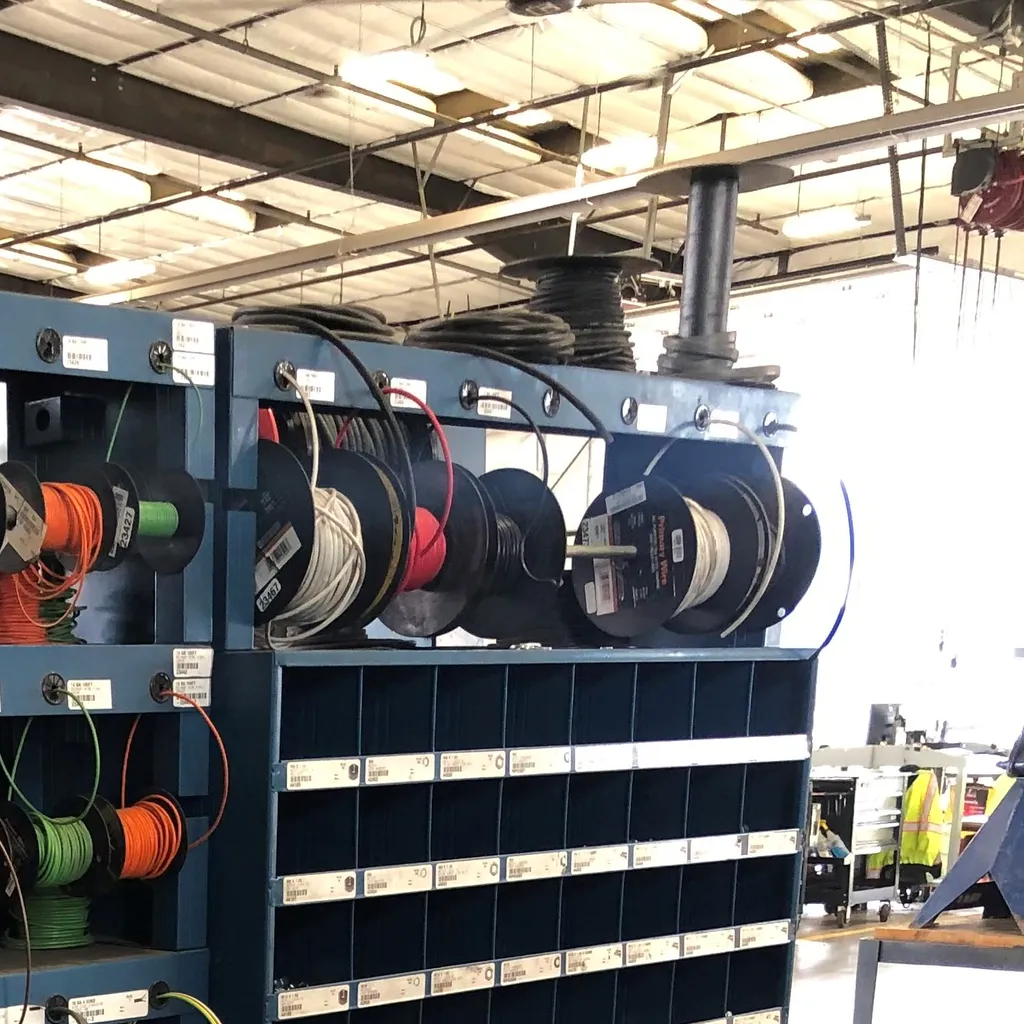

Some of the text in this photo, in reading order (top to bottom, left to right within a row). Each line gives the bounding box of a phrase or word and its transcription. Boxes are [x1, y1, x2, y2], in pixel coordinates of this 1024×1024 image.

[120, 511, 133, 547] 23427
[658, 515, 668, 586] Primary Wire
[259, 583, 279, 610] 23467
